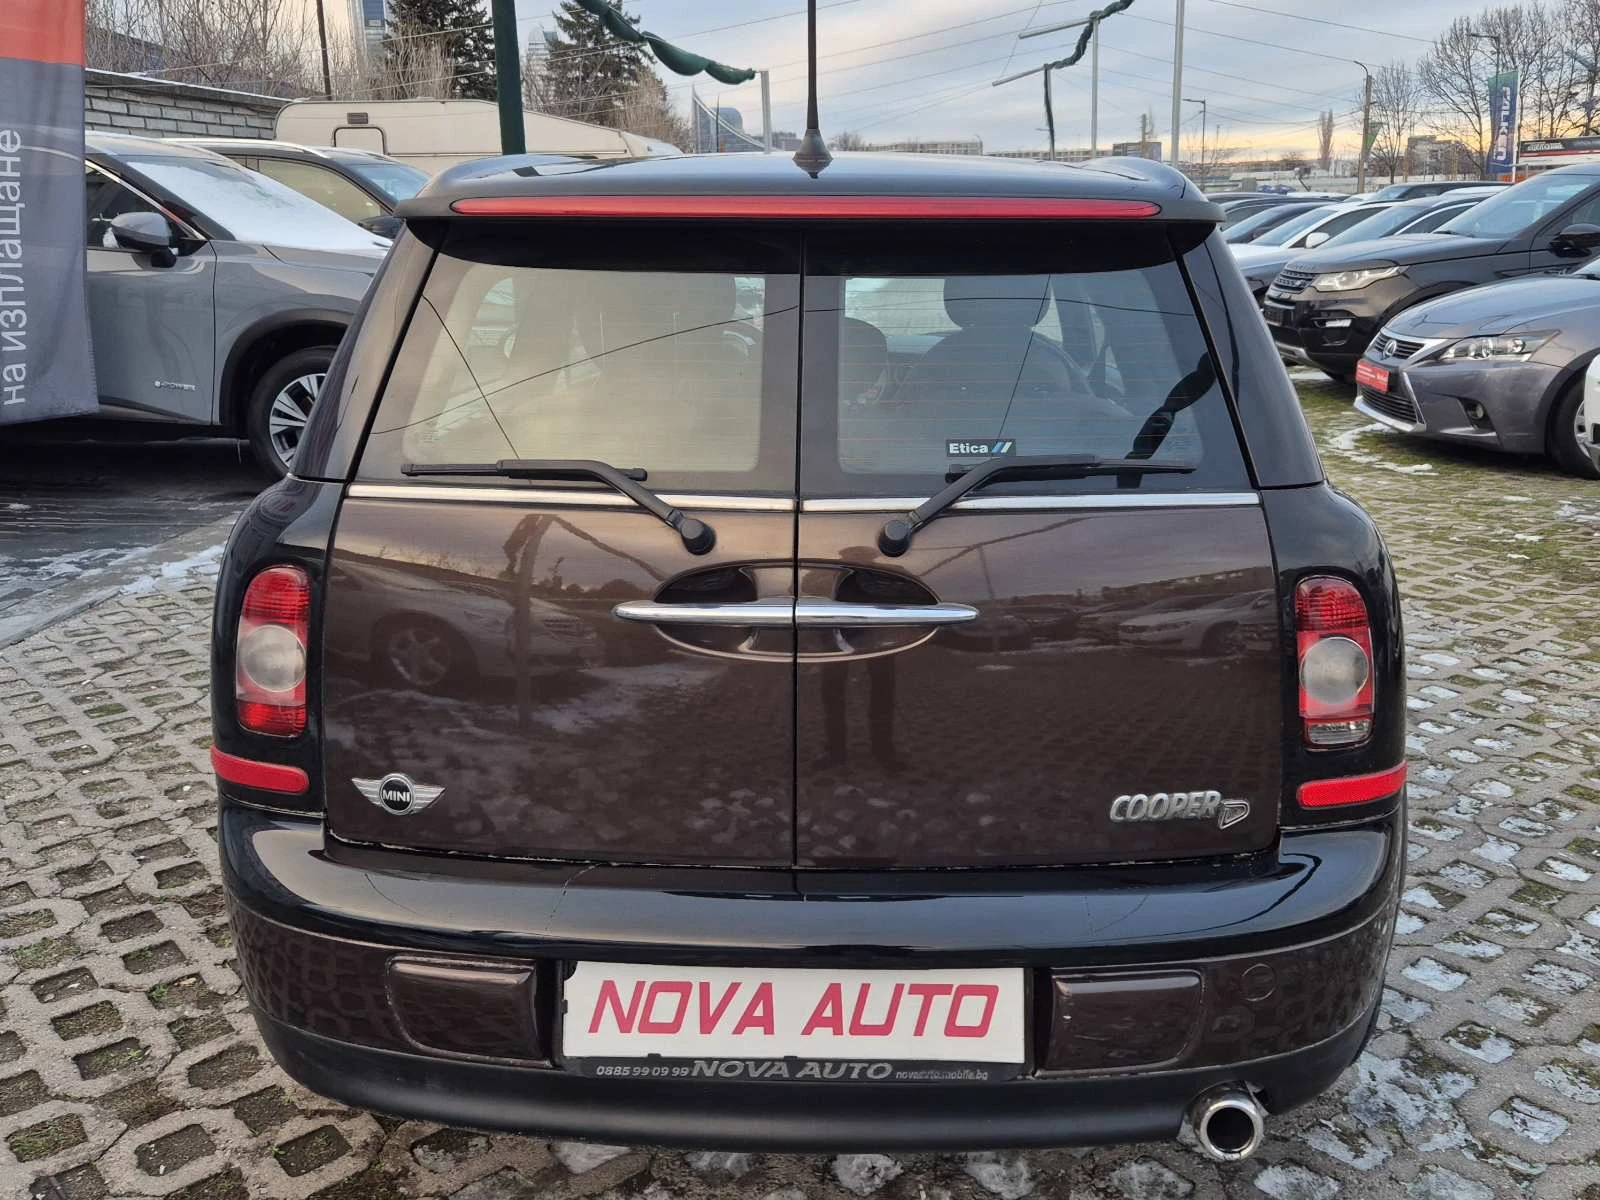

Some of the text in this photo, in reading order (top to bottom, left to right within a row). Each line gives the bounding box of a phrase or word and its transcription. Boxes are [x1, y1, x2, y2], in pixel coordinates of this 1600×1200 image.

[0, 128, 27, 406] на изплащане
[949, 442, 989, 454] Etica
[382, 789, 411, 803] MINI
[1109, 790, 1221, 822] COOPER
[588, 980, 999, 1038] NOVA AUTO
[596, 1065, 689, 1077] 0885 99 09 99
[691, 1060, 893, 1080] NOVA AUTO
